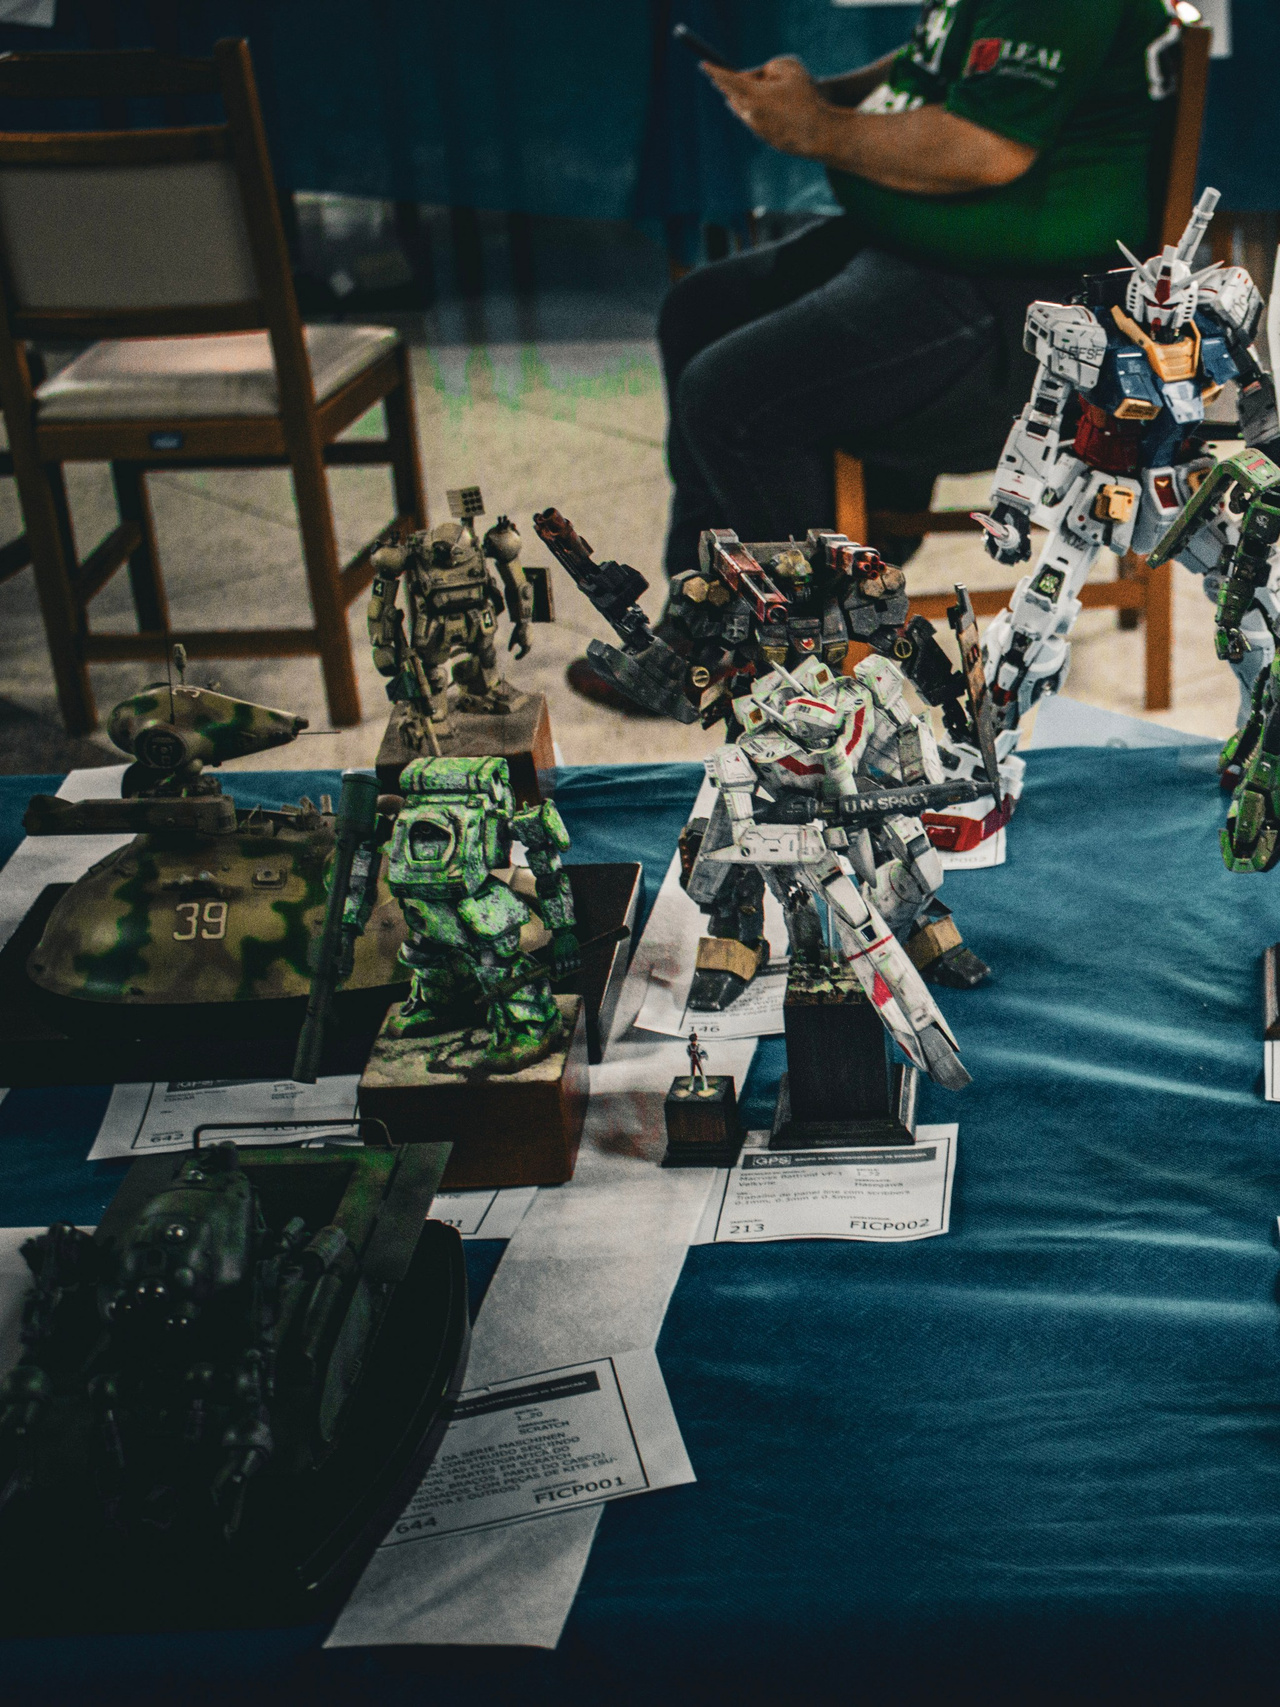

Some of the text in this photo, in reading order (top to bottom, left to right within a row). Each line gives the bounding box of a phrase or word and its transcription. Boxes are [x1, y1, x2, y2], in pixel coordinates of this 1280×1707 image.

[1068, 345, 1105, 361] EFSF
[172, 902, 228, 941] 39
[753, 1155, 791, 1165] GPS
[729, 1223, 765, 1234] 213
[849, 1218, 930, 1231] FICP002
[518, 1420, 570, 1435] SCRATCH
[534, 1475, 627, 1505] FICP001
[395, 1516, 437, 1535] 644
